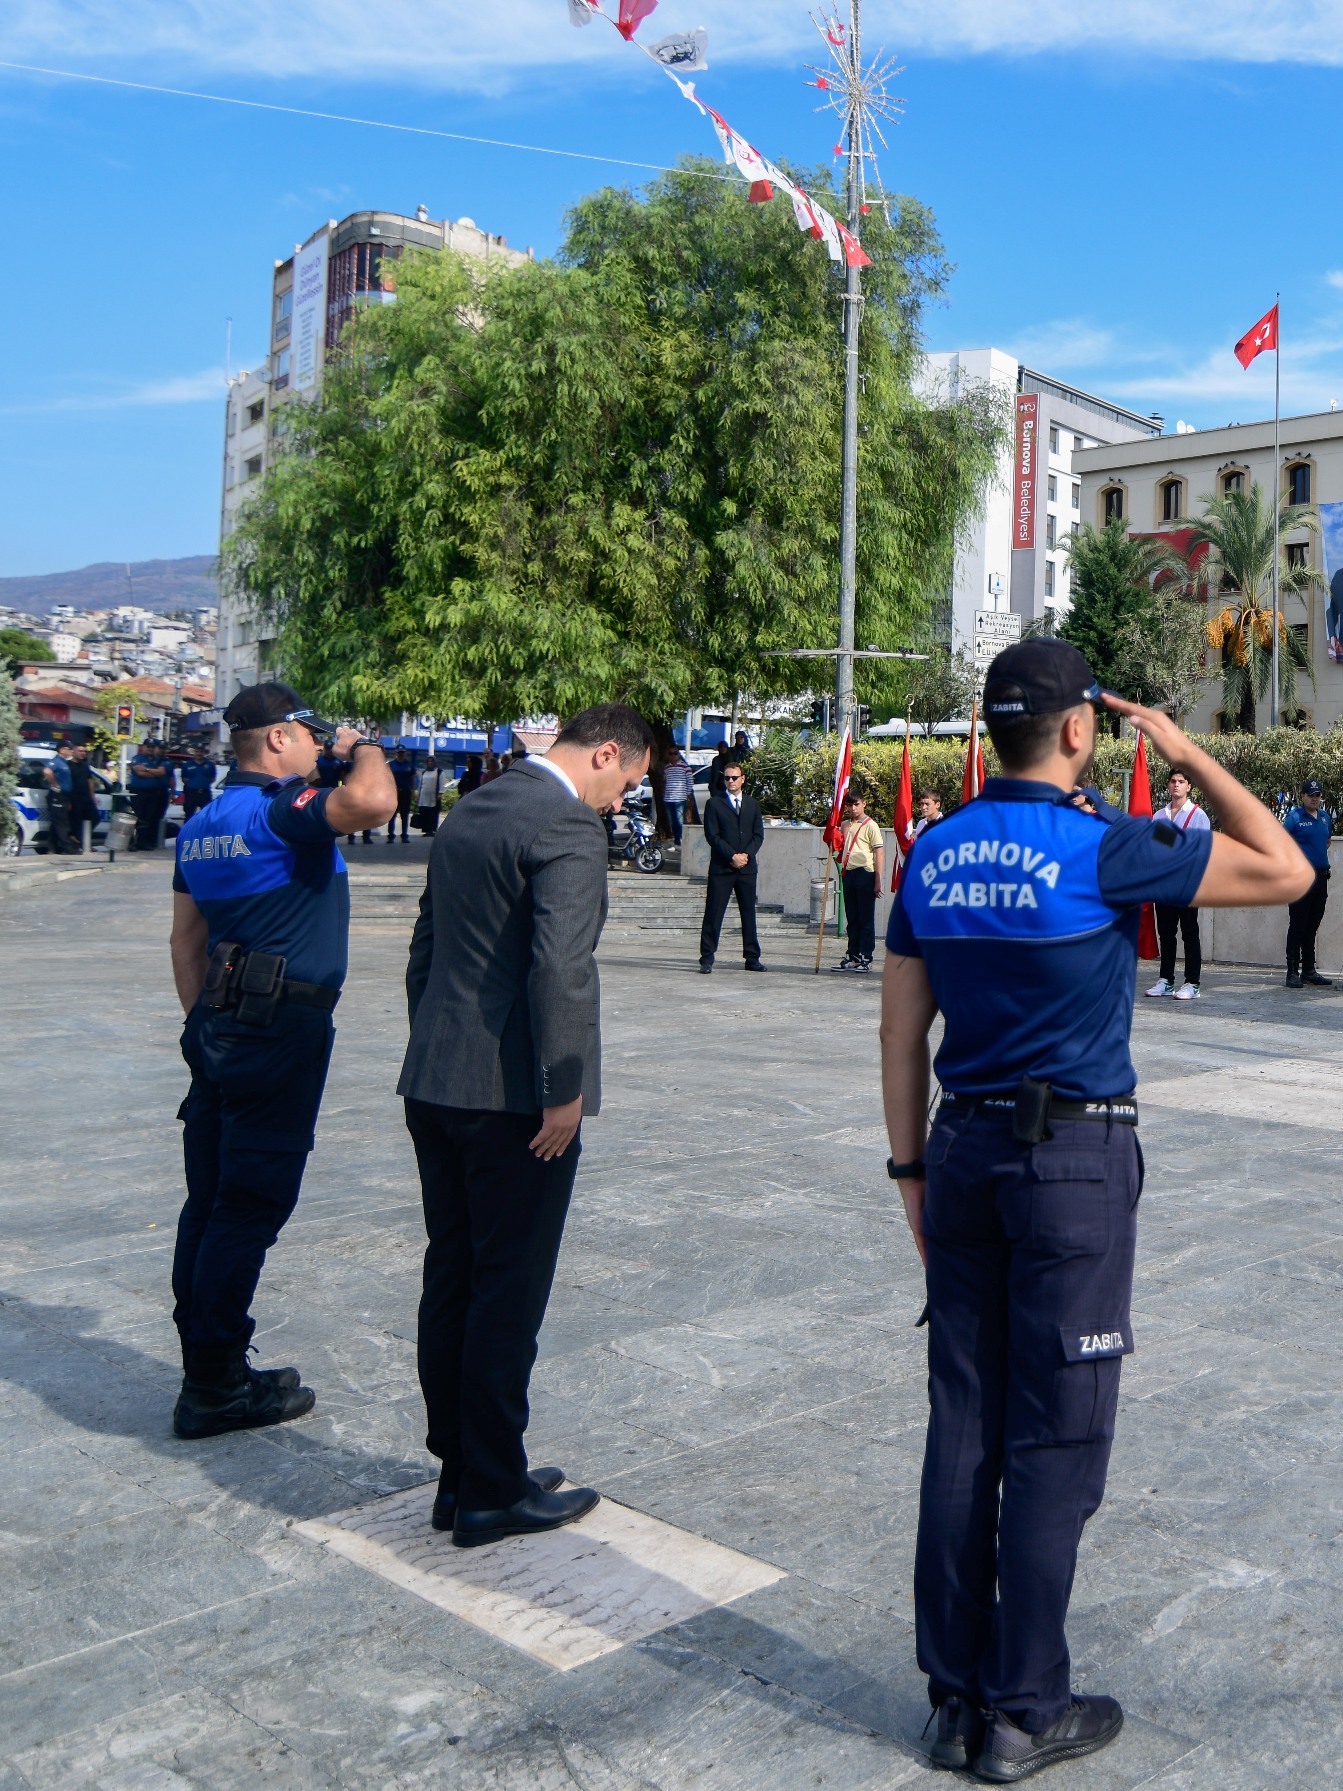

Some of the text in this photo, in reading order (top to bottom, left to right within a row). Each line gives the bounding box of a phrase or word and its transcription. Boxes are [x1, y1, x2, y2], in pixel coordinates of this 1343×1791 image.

[1018, 420, 1035, 541] Bornova Belediyesi
[1000, 615, 1018, 623] Veyse
[992, 703, 1024, 712] ZABITA
[180, 834, 252, 862] ZABITA
[920, 840, 1061, 890] BORNOVA
[928, 882, 1039, 909] ZABITA
[1085, 1103, 1135, 1116] ZABITA
[1079, 1331, 1124, 1353] ZABITA
